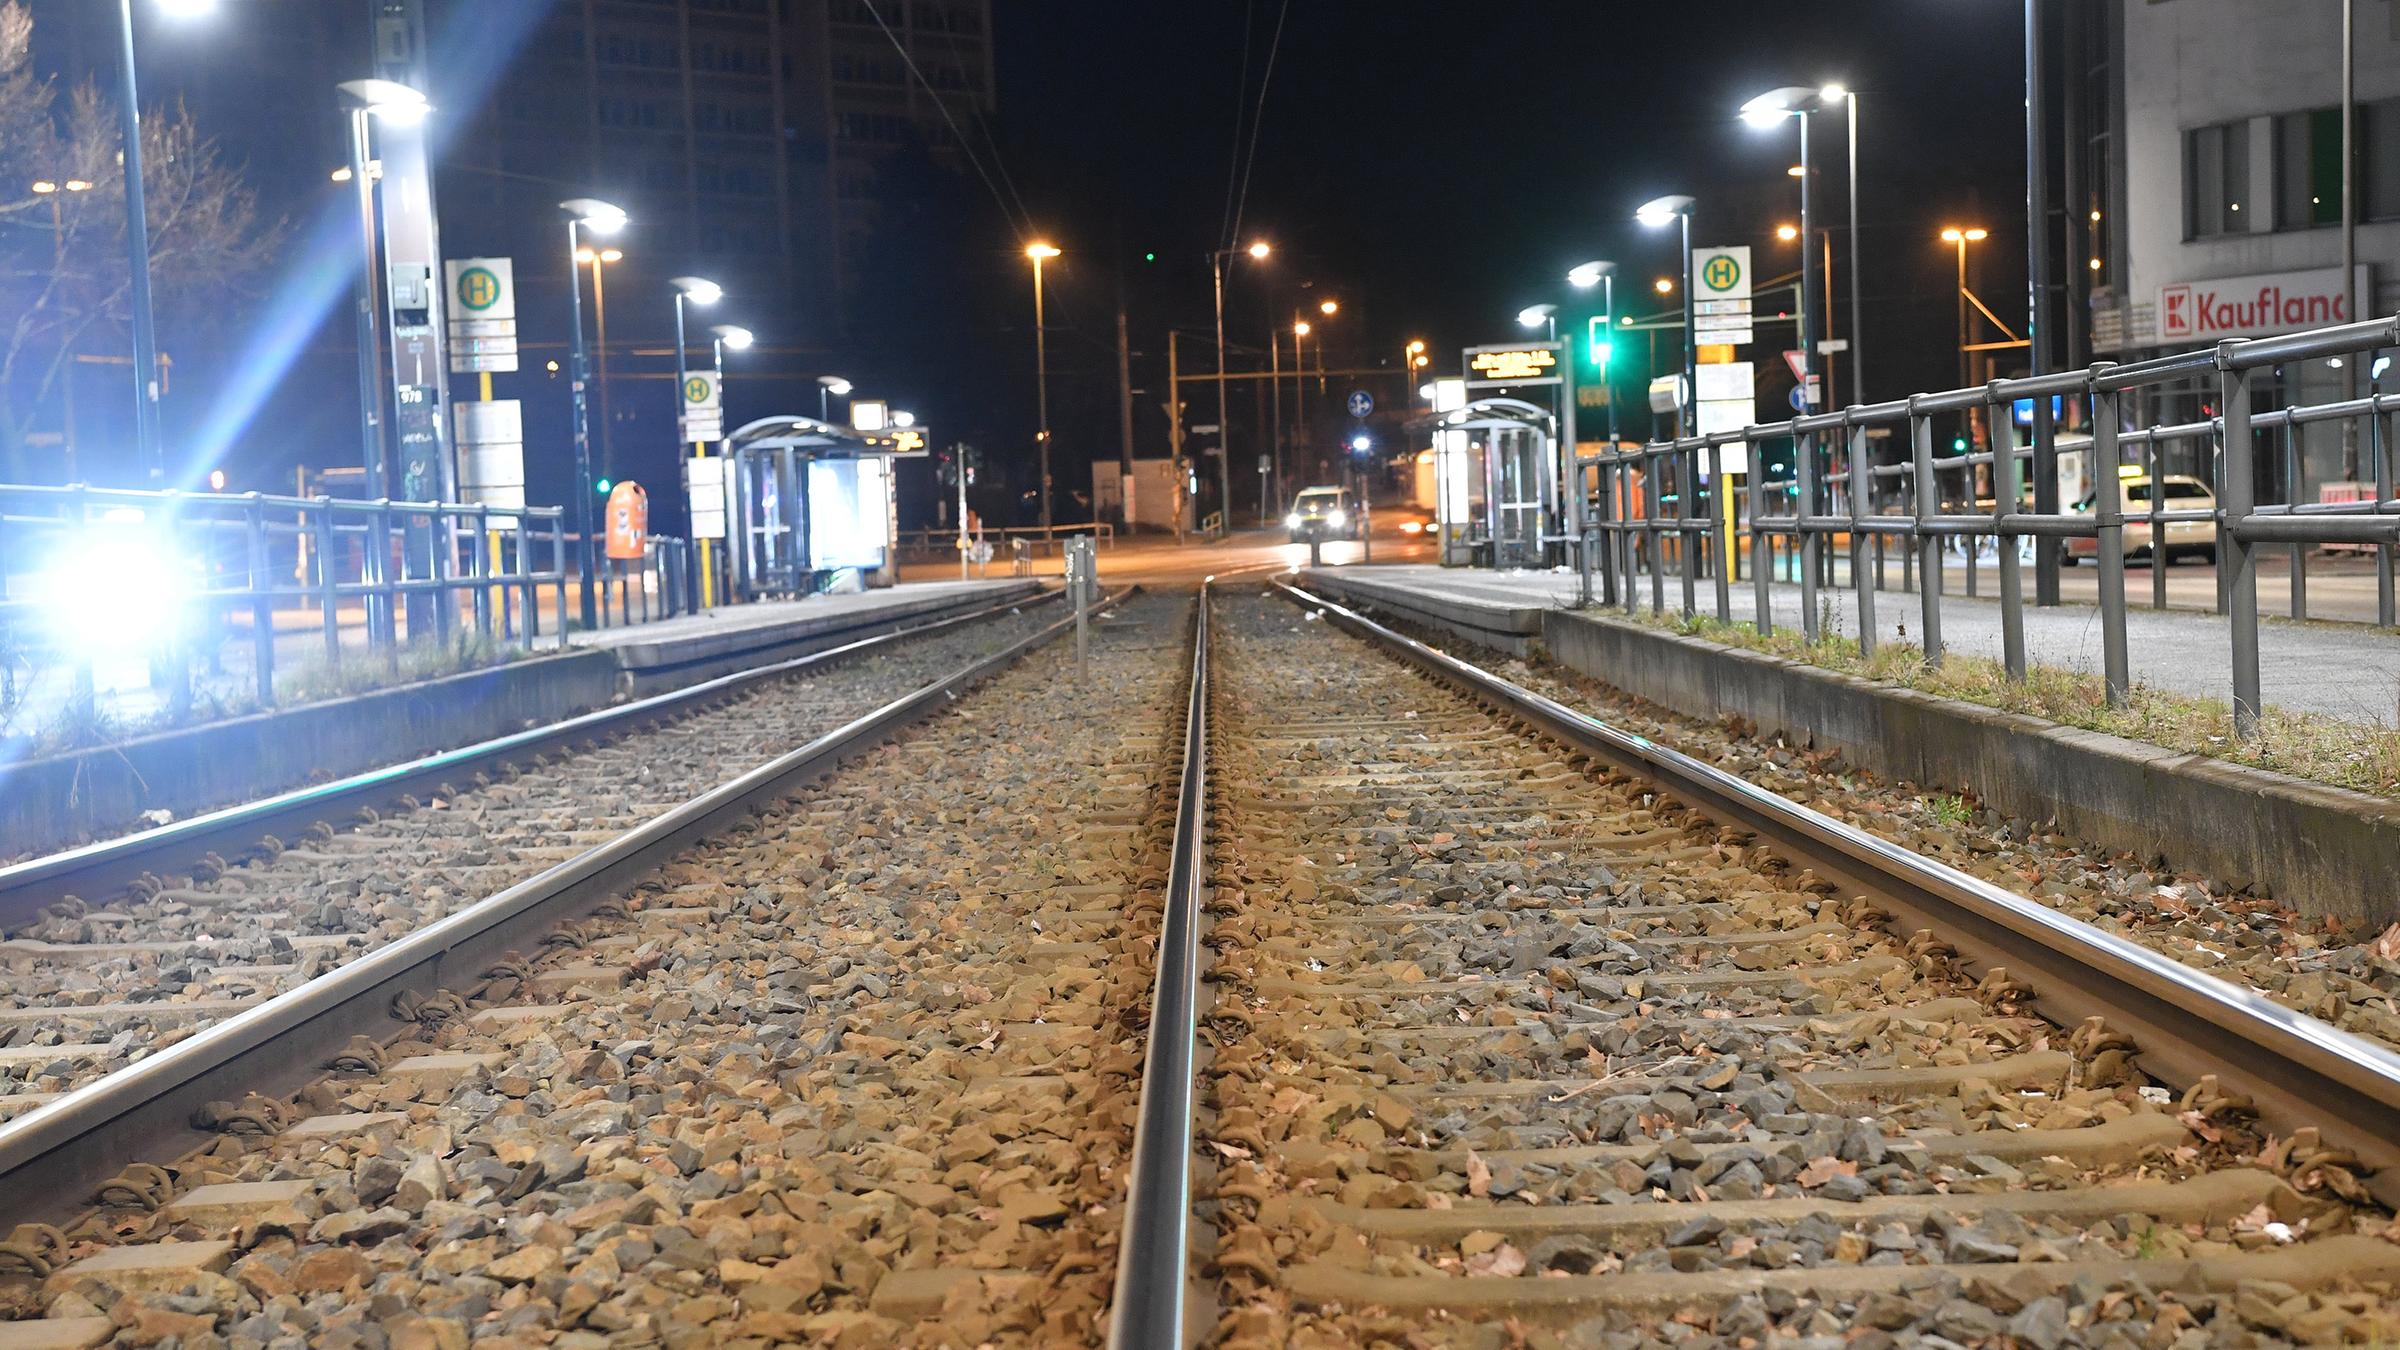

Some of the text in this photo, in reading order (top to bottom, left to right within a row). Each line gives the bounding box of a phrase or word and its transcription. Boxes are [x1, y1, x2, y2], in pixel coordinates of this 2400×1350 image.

[1712, 264, 1730, 283] H
[469, 277, 487, 302] H
[2167, 294, 2186, 329] K
[690, 383, 703, 397] H
